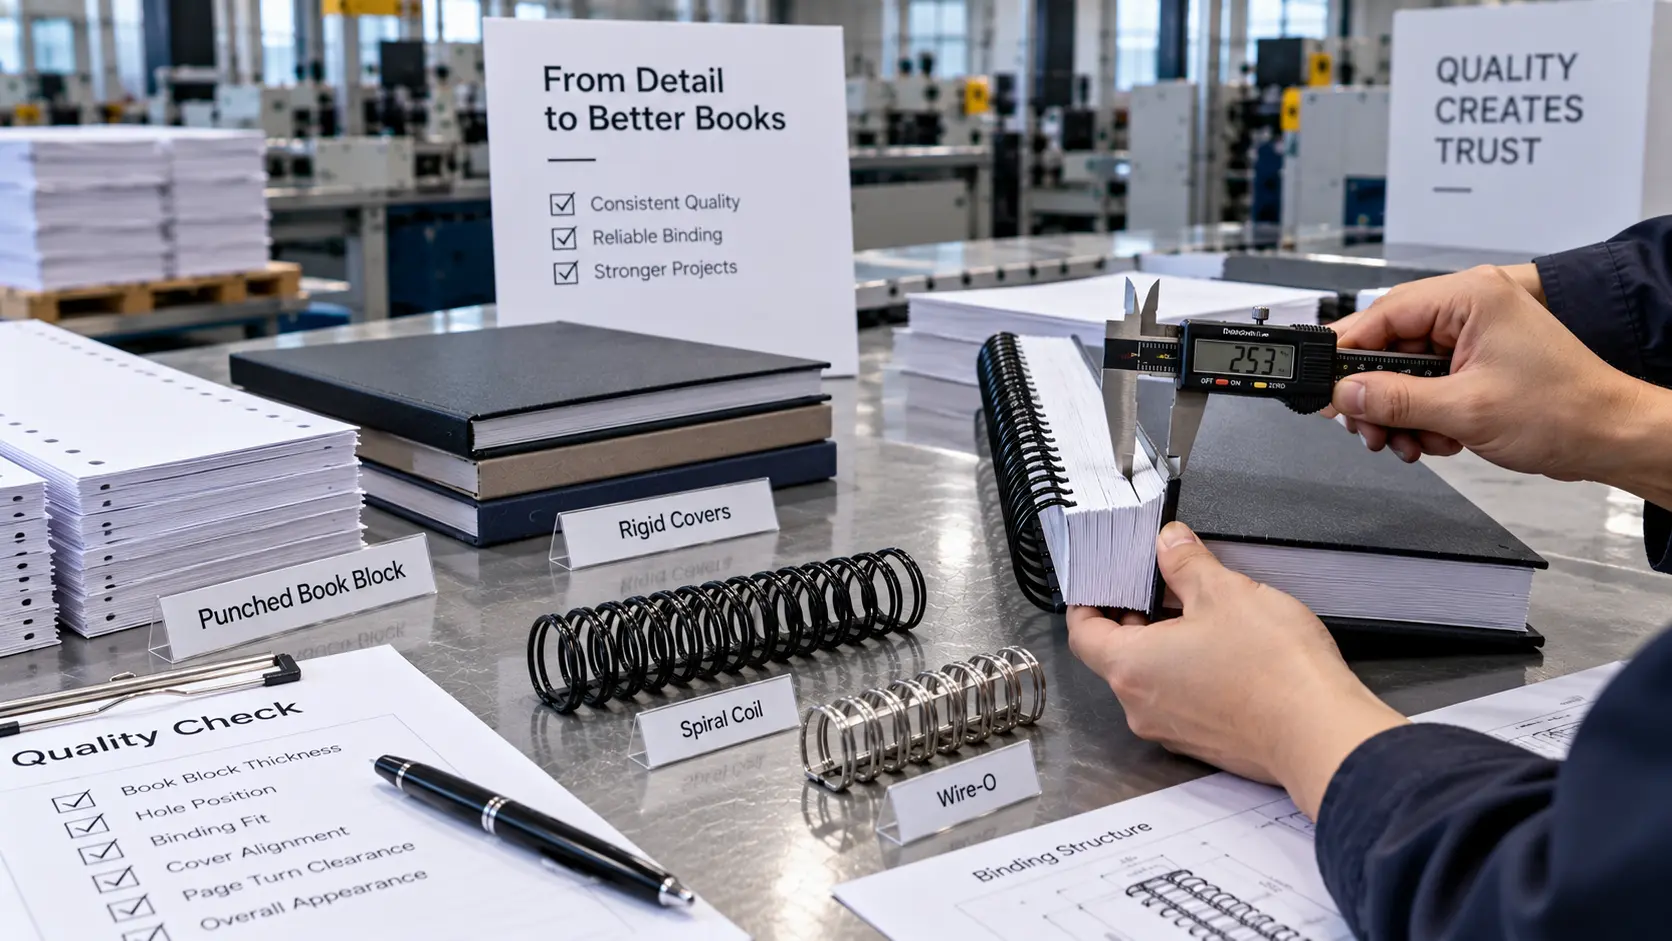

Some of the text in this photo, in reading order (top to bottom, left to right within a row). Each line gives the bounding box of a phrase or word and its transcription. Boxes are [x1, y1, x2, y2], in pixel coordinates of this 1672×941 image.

[544, 65, 724, 94] From Detail
[1436, 52, 1578, 86] QUALITY
[545, 105, 786, 131] to Better Books
[1435, 94, 1584, 124] CREATES
[1434, 137, 1542, 165] TRUST
[591, 193, 740, 212] Consistent Quality
[593, 226, 723, 246] Reliable Binding
[594, 260, 738, 281] Stronger Projects
[619, 505, 731, 540] Rigid Covers
[198, 560, 406, 629] Punched Book Block
[12, 701, 304, 769] Quality Check
[680, 700, 764, 740] Spiral Coil
[121, 742, 343, 797] Book Block Thickness
[135, 784, 277, 822] Hole Position
[936, 773, 997, 808] Wire-O
[150, 812, 271, 848] Binding Fit
[166, 826, 350, 874] Cover Alignment
[972, 820, 1153, 884] Binding Structure
[182, 840, 416, 903] Page Turn Clearance
[200, 868, 429, 932] Overall Appearance
